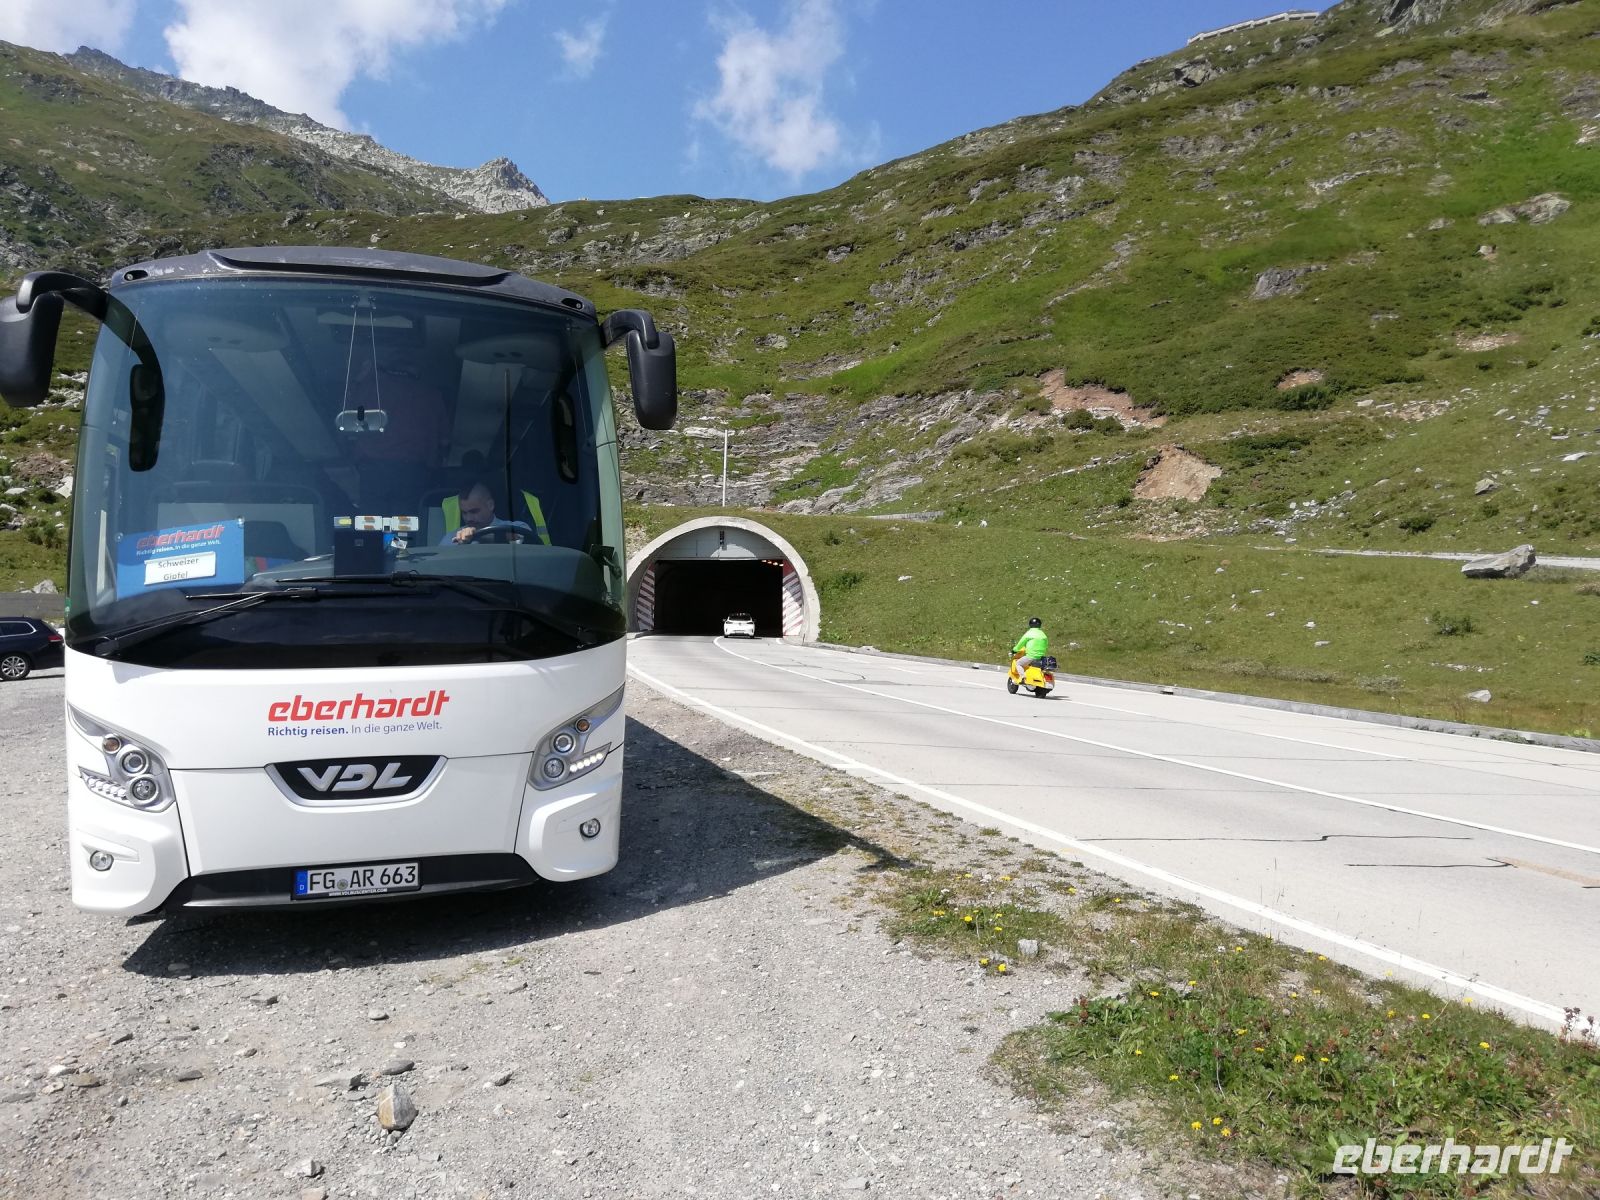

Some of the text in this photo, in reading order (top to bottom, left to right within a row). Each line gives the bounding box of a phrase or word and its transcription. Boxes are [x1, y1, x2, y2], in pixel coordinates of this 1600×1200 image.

[136, 525, 225, 549] eberhardt
[158, 557, 199, 568] Schweizer
[163, 571, 188, 581] Gipfel
[268, 690, 450, 722] eberhardt
[268, 720, 443, 738] Richtig reisen. In die ganze Welt.
[297, 762, 413, 792] VDL
[309, 865, 416, 891] FG AR 663
